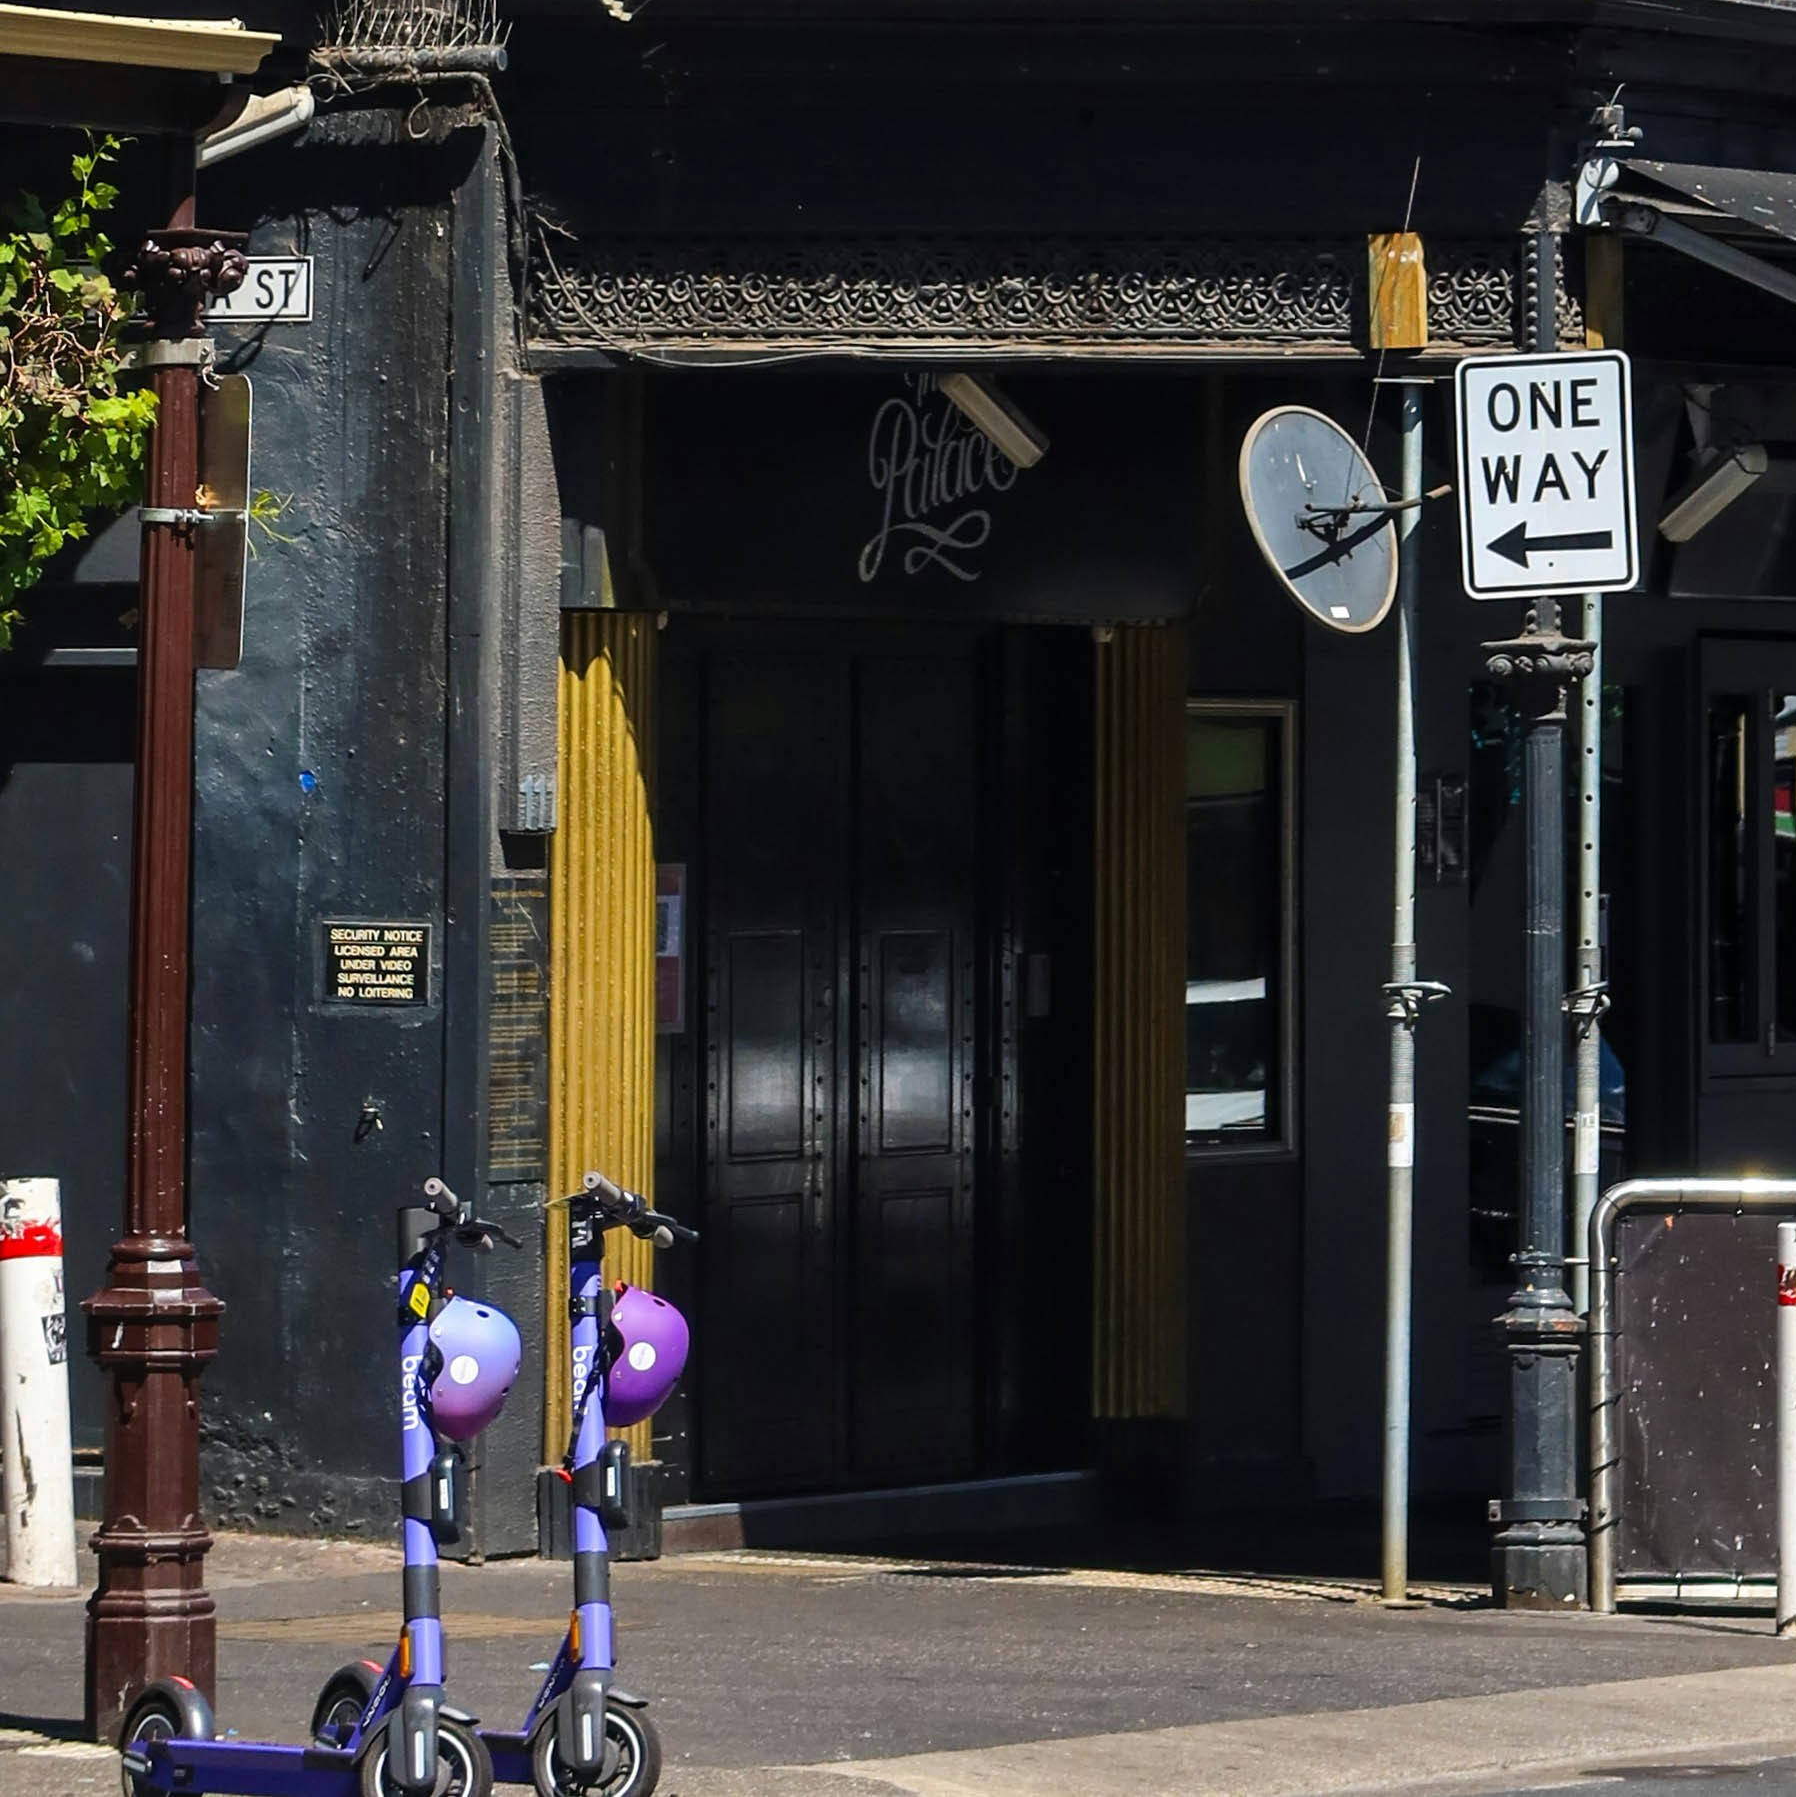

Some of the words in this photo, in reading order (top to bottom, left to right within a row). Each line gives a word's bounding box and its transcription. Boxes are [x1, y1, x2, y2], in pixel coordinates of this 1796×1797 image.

[255, 269, 296, 309] ST
[1487, 378, 1600, 432] ONE
[1481, 449, 1609, 505] WAY
[330, 929, 380, 941] SECURITY
[384, 930, 423, 942] NOTICE
[334, 945, 385, 957] LICENSED
[389, 946, 418, 958] AREA
[340, 959, 375, 970] UNDER
[381, 960, 412, 971] VIDEO
[337, 973, 414, 985] SURVEILLANCE
[337, 987, 355, 997] NO
[359, 987, 413, 999] LOITERING
[402, 1354, 423, 1431] beam
